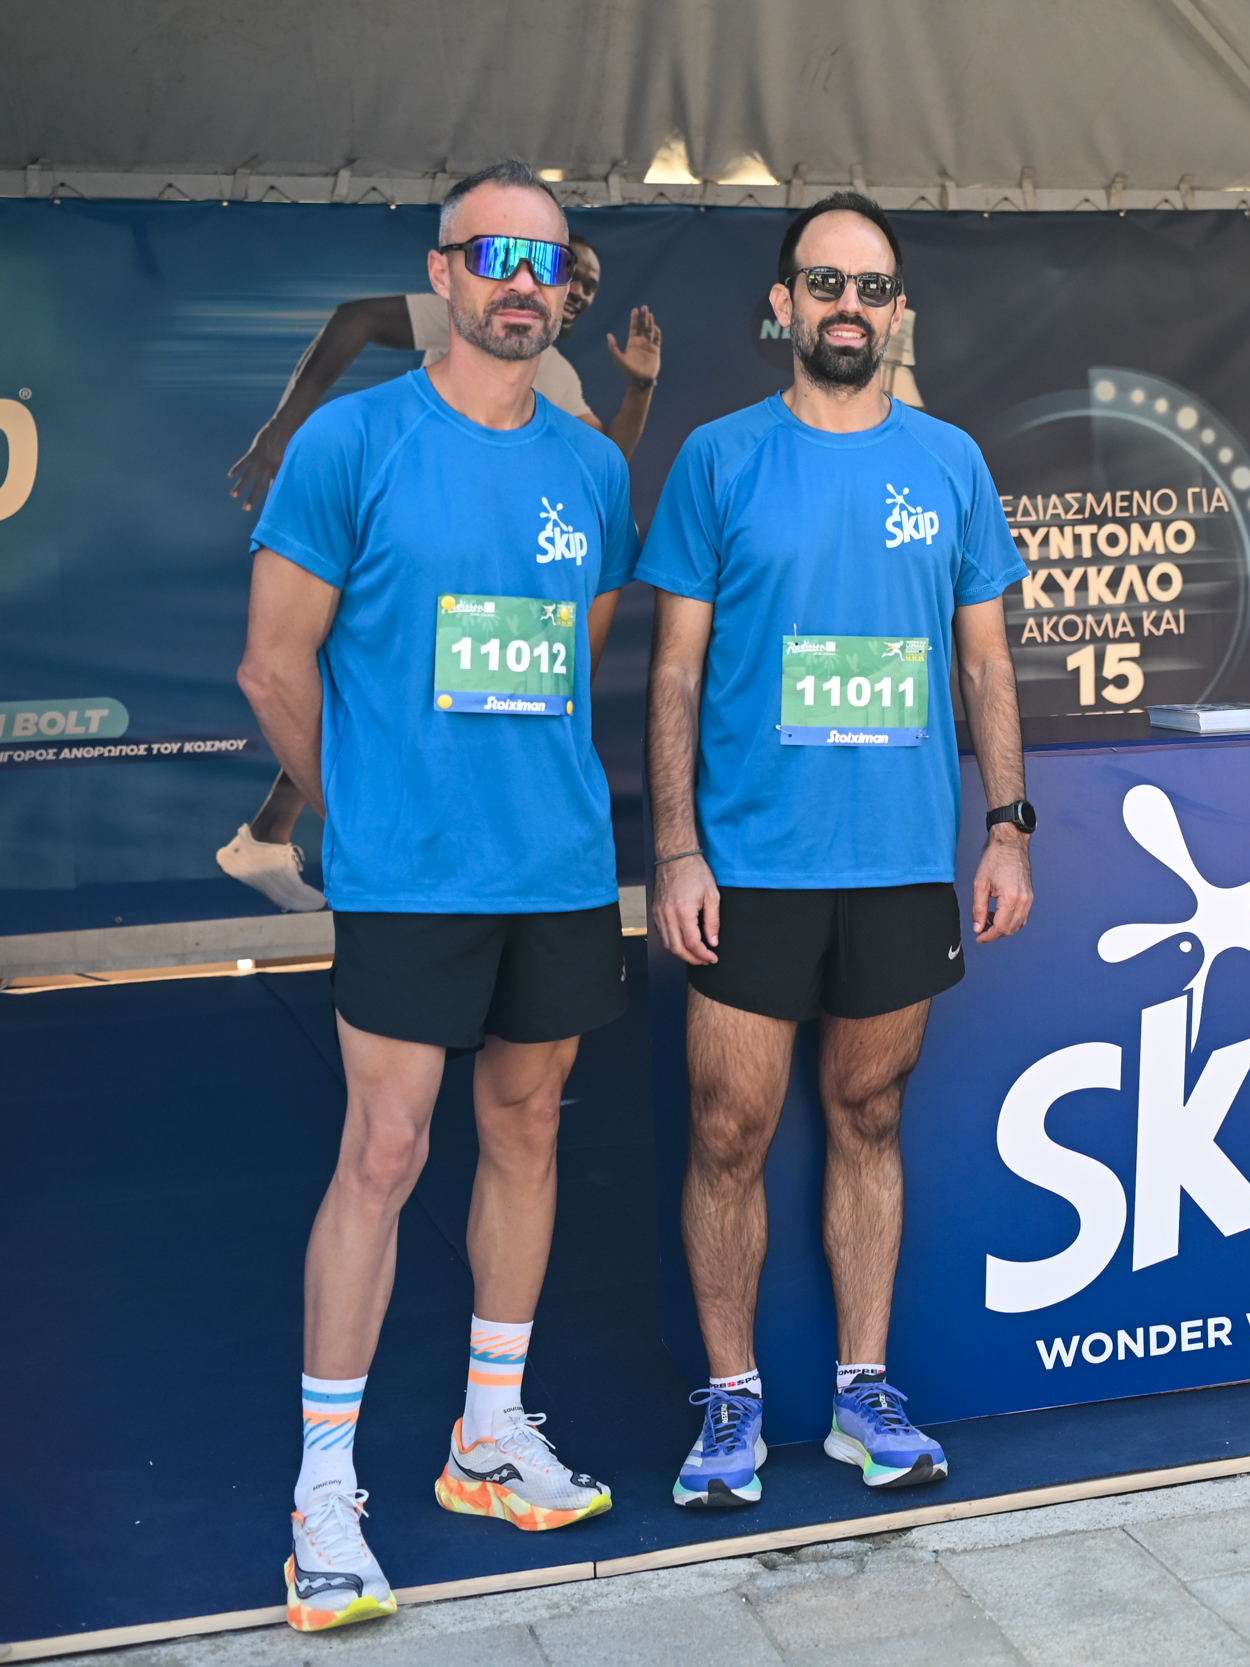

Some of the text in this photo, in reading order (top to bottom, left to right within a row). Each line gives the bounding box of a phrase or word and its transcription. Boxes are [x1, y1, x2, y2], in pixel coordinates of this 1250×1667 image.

[1000, 487, 1230, 522] ΕΔΙΑΣΜΕΝΟ ΓΙΑ
[885, 506, 939, 548] Skip
[1009, 520, 1196, 560] ΥΝΤΟΜΟ
[536, 525, 588, 566] Skip
[1021, 562, 1183, 609] ΚΥΚΛΟ
[1021, 608, 1185, 644] ΑΚΟΜΑ ΚΑΙ
[451, 637, 567, 674] 11012
[796, 675, 914, 707] 11011
[1066, 642, 1145, 706] 15
[484, 696, 546, 711] Stoiximan
[12, 709, 109, 738] BOLT
[827, 730, 889, 744] Stoiximan
[59, 744, 148, 760] ΑΝΘΡΩΠΟΣ
[151, 742, 182, 755] ΤΟΥ
[183, 739, 248, 753] ΚΟΣΜΟΥ
[1035, 1316, 1233, 1370] WONDER
